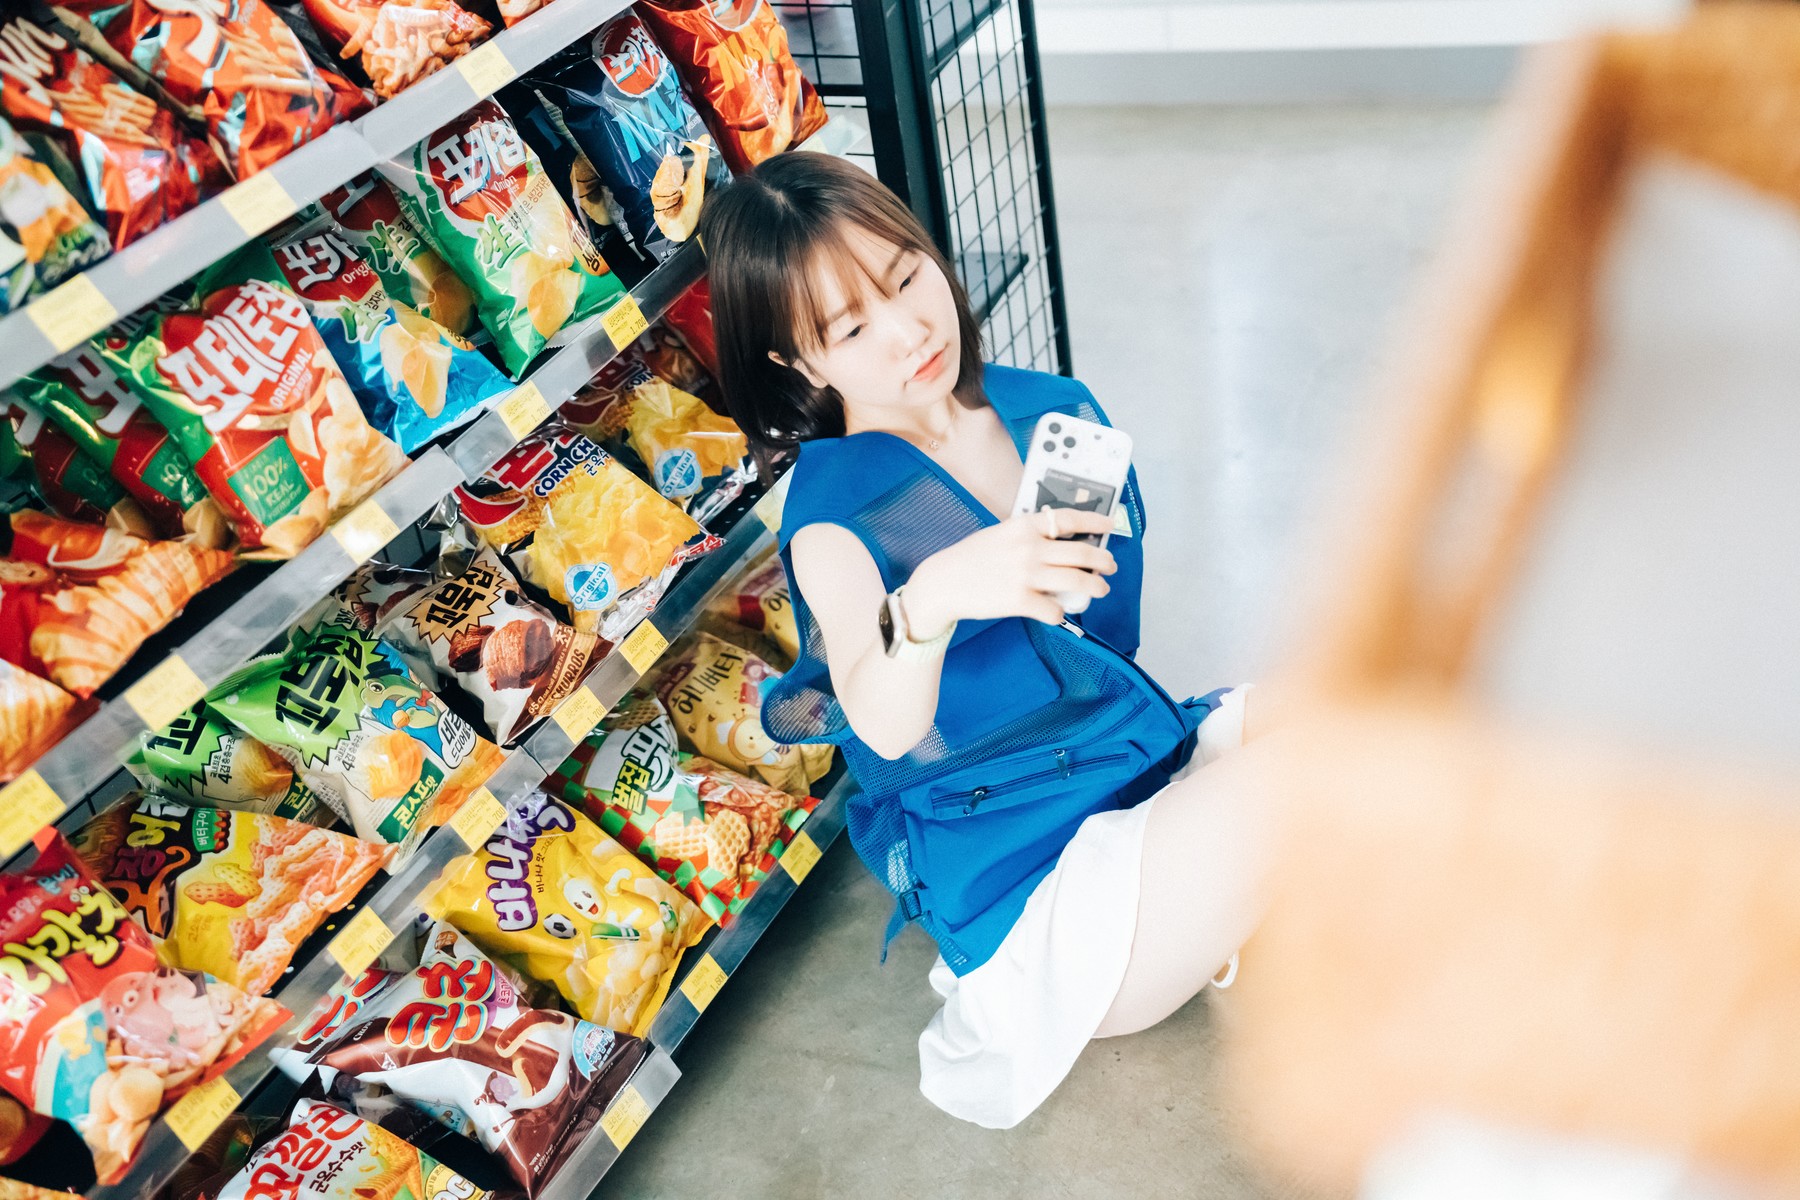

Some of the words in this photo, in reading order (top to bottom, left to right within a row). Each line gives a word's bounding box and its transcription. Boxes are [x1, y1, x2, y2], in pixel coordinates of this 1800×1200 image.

[429, 116, 527, 206] 포카칩
[492, 175, 518, 192] Onion
[156, 279, 312, 434] 포테토칩
[270, 347, 313, 408] ORIGINAL
[244, 456, 290, 500] 100%
[267, 480, 296, 505] REAL
[534, 457, 575, 497] CORN
[664, 451, 695, 495] Original
[425, 567, 495, 629] 꼬북칩
[574, 564, 608, 605] Original
[551, 648, 586, 700] CHURROS
[672, 650, 743, 715] 허니버터
[393, 776, 439, 830] 콘스프맛
[611, 758, 651, 815] 벌집
[384, 957, 497, 1052] 콘초
[243, 1103, 365, 1200] 꼬깔콘
[308, 1140, 367, 1194] 군옥수수맛
